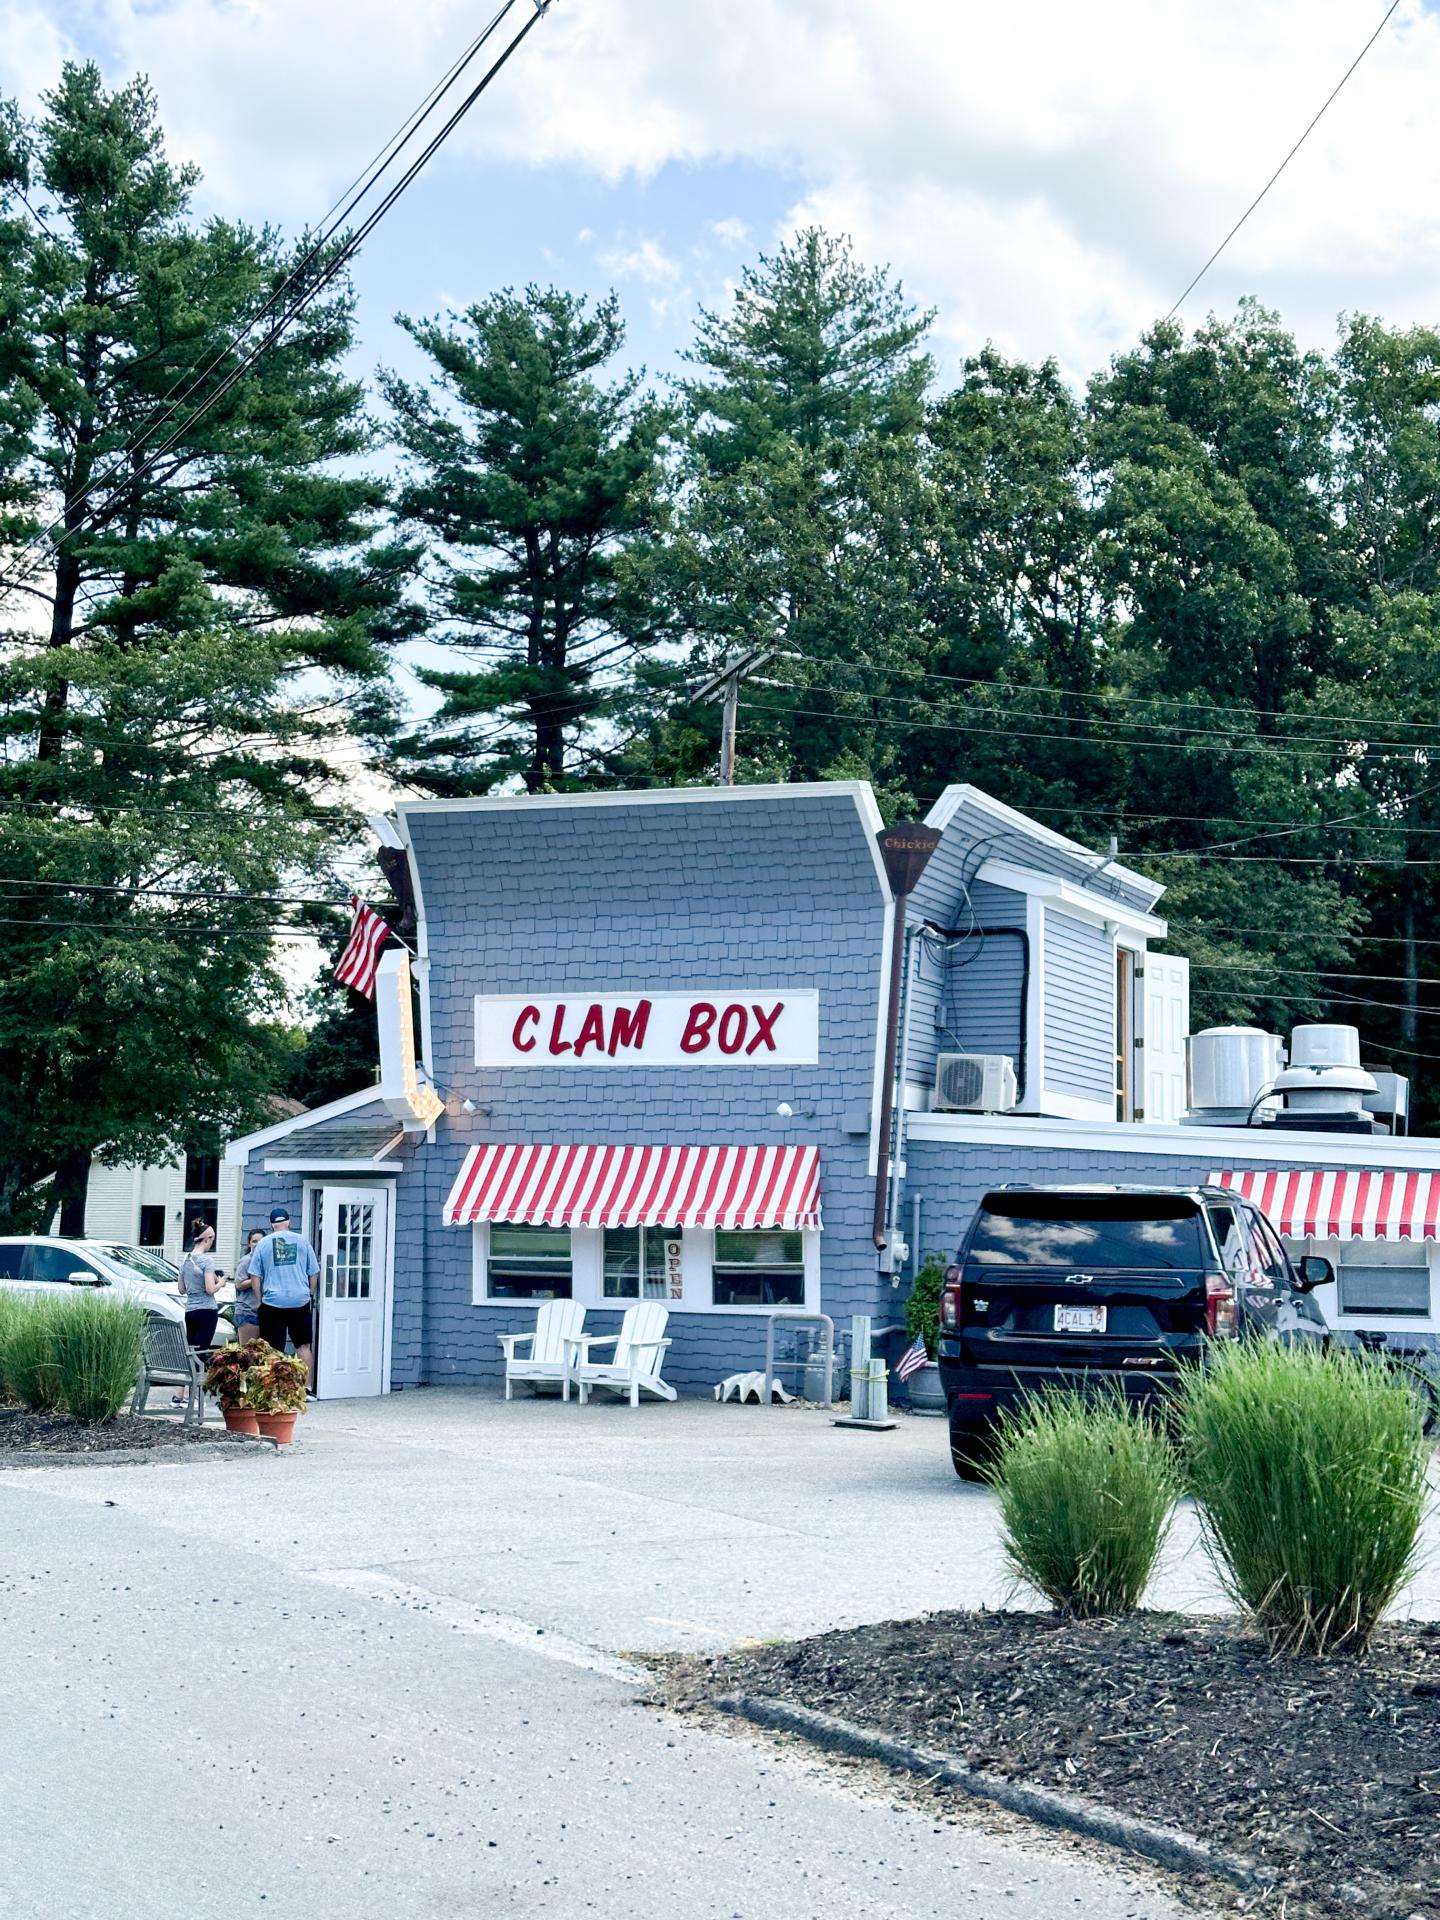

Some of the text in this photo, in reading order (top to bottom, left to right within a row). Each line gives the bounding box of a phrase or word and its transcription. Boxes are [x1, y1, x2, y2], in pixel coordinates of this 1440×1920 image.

[512, 1000, 784, 1057] CLAM BOX
[668, 1243, 683, 1299] OPEN
